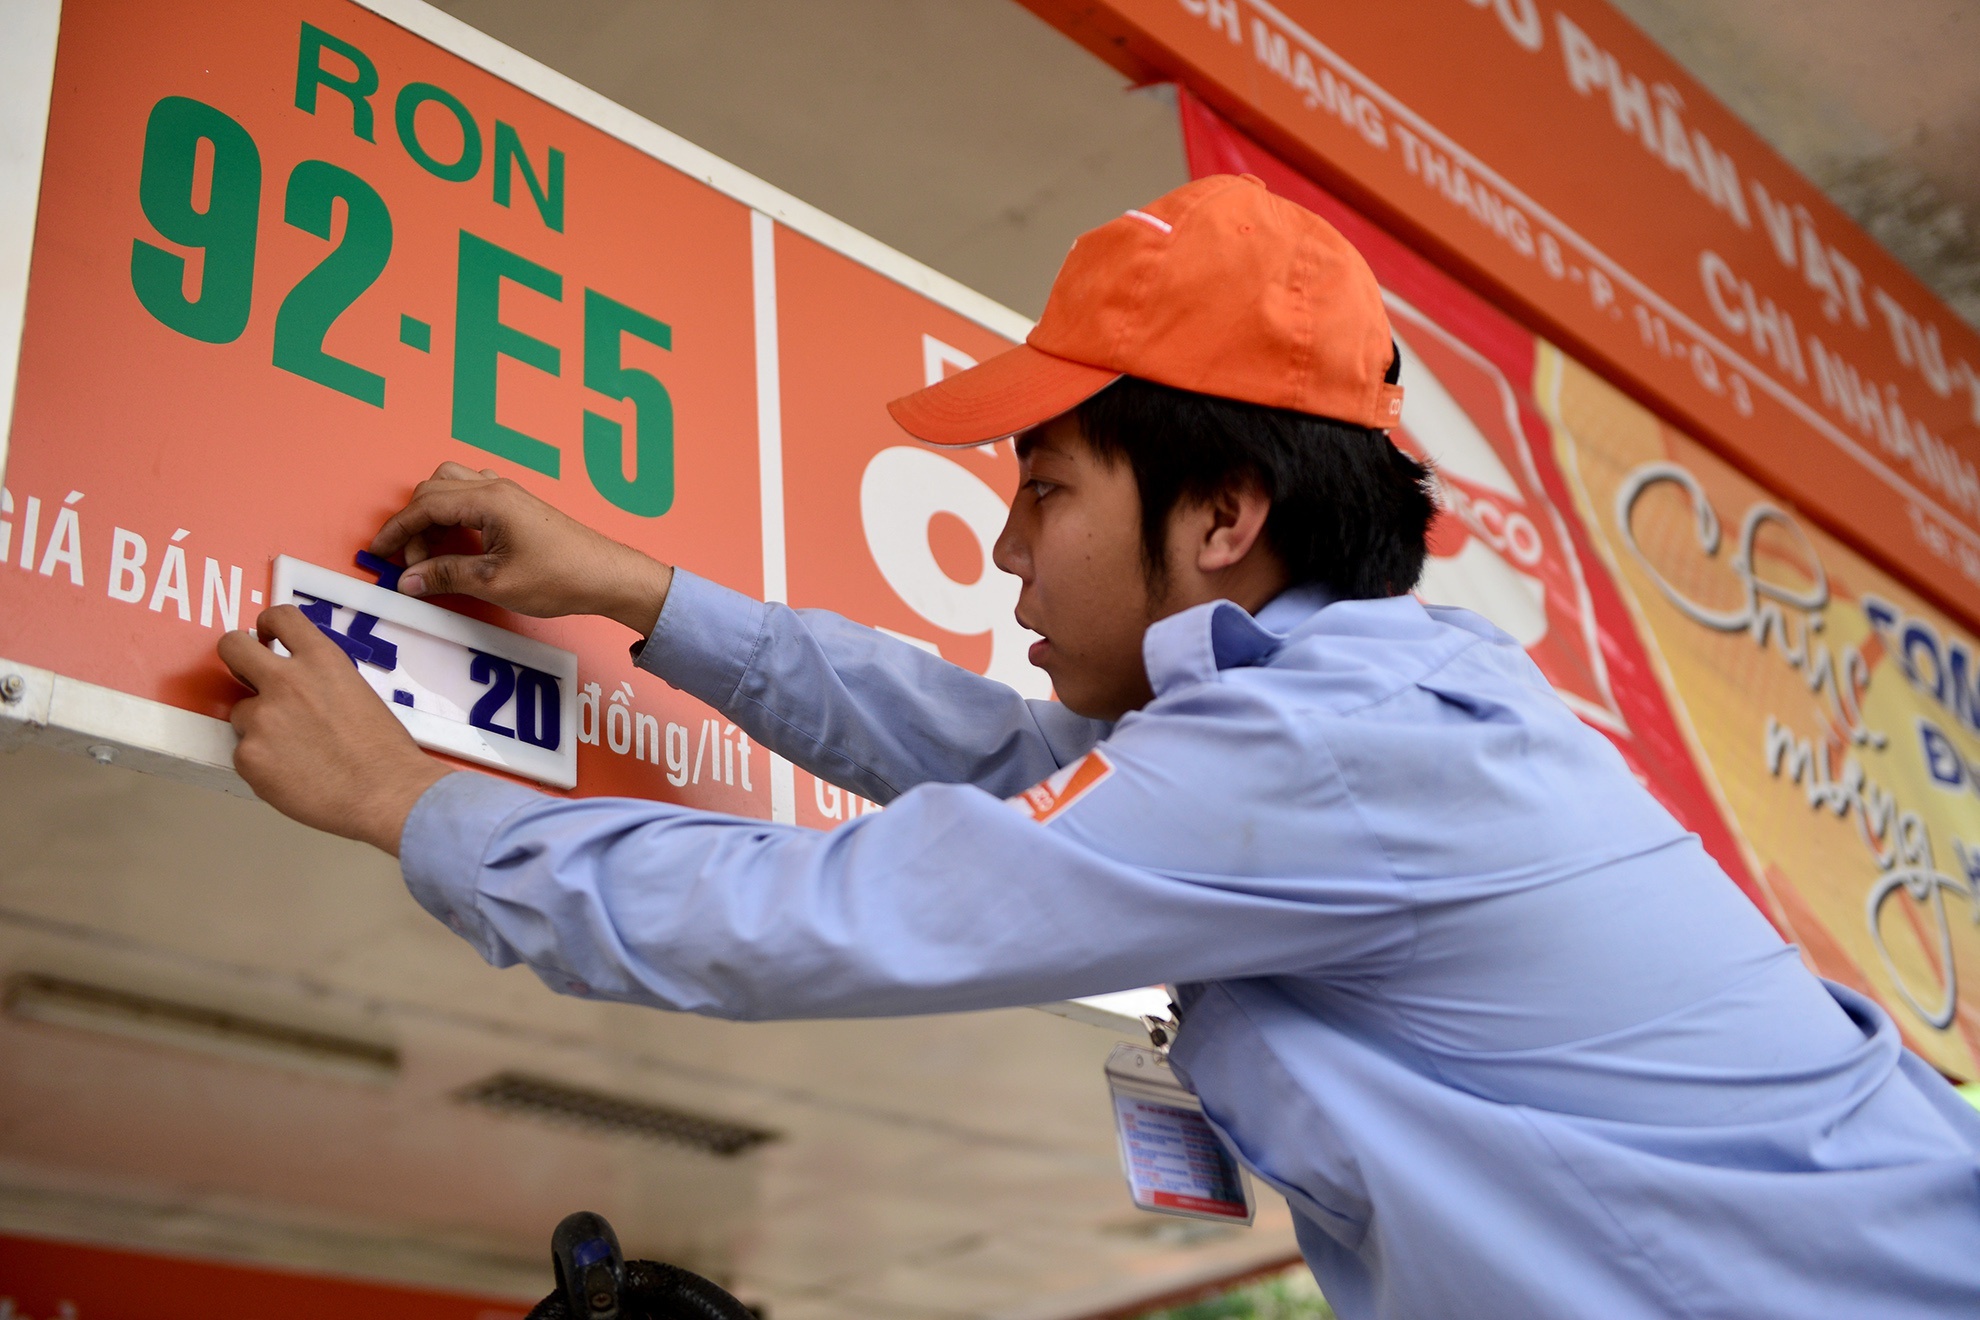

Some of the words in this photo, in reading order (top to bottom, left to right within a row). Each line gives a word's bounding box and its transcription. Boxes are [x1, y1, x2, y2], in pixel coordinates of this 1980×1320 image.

[295, 20, 566, 235] RON
[1250, 16, 1389, 150] MẠNG
[1393, 122, 1536, 260] THÁNG
[1700, 250, 1810, 386] CHI
[576, 680, 753, 793] đồng/lít
